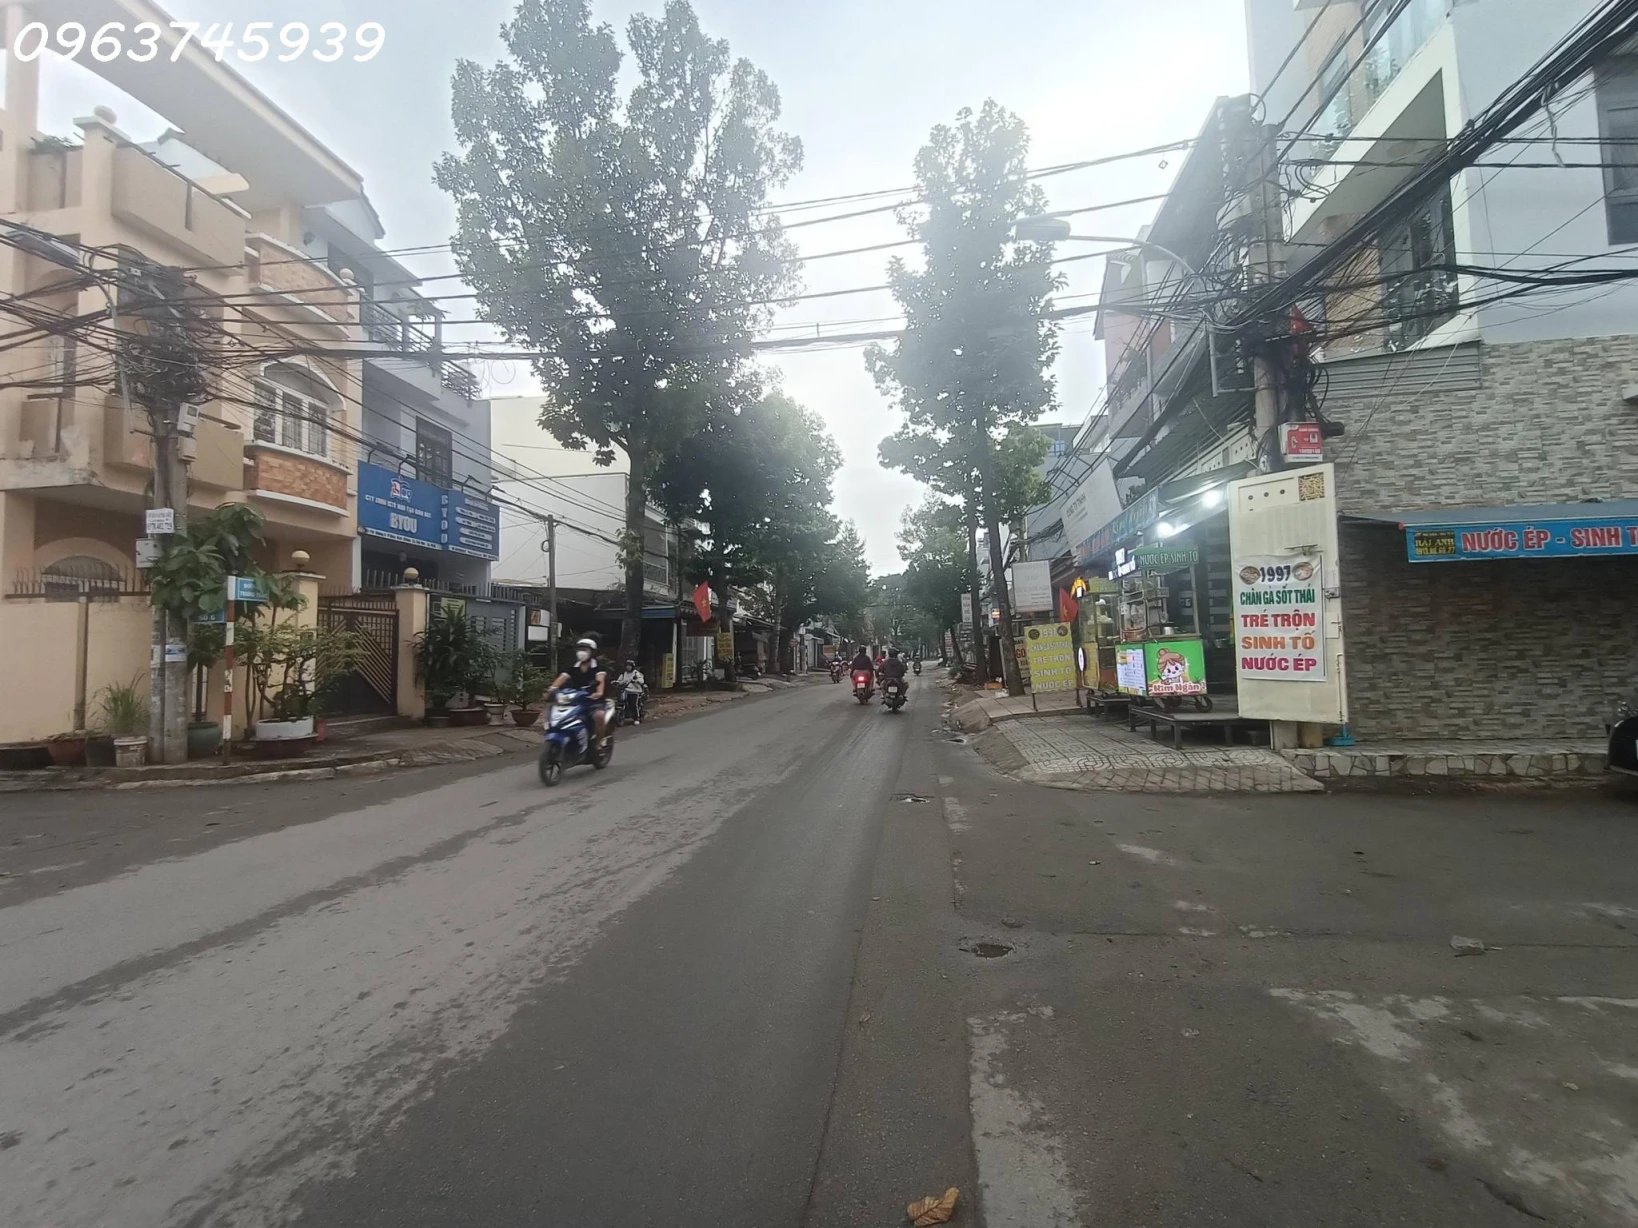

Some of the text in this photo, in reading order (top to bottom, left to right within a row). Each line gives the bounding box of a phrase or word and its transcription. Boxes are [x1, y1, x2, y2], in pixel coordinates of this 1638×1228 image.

[389, 512, 418, 533] BYOU
[1461, 528, 1519, 552] NƯỚC
[1523, 527, 1550, 549] ÉP
[1570, 527, 1622, 548] SINH
[1260, 565, 1291, 582] 1997
[1240, 583, 1315, 606] CHÂN GÀ SỐT THÁI
[1241, 609, 1316, 631] TRÉ TRỘN
[1241, 630, 1315, 650] SINH TỐ
[1241, 652, 1317, 671] NƯỚC ÉP
